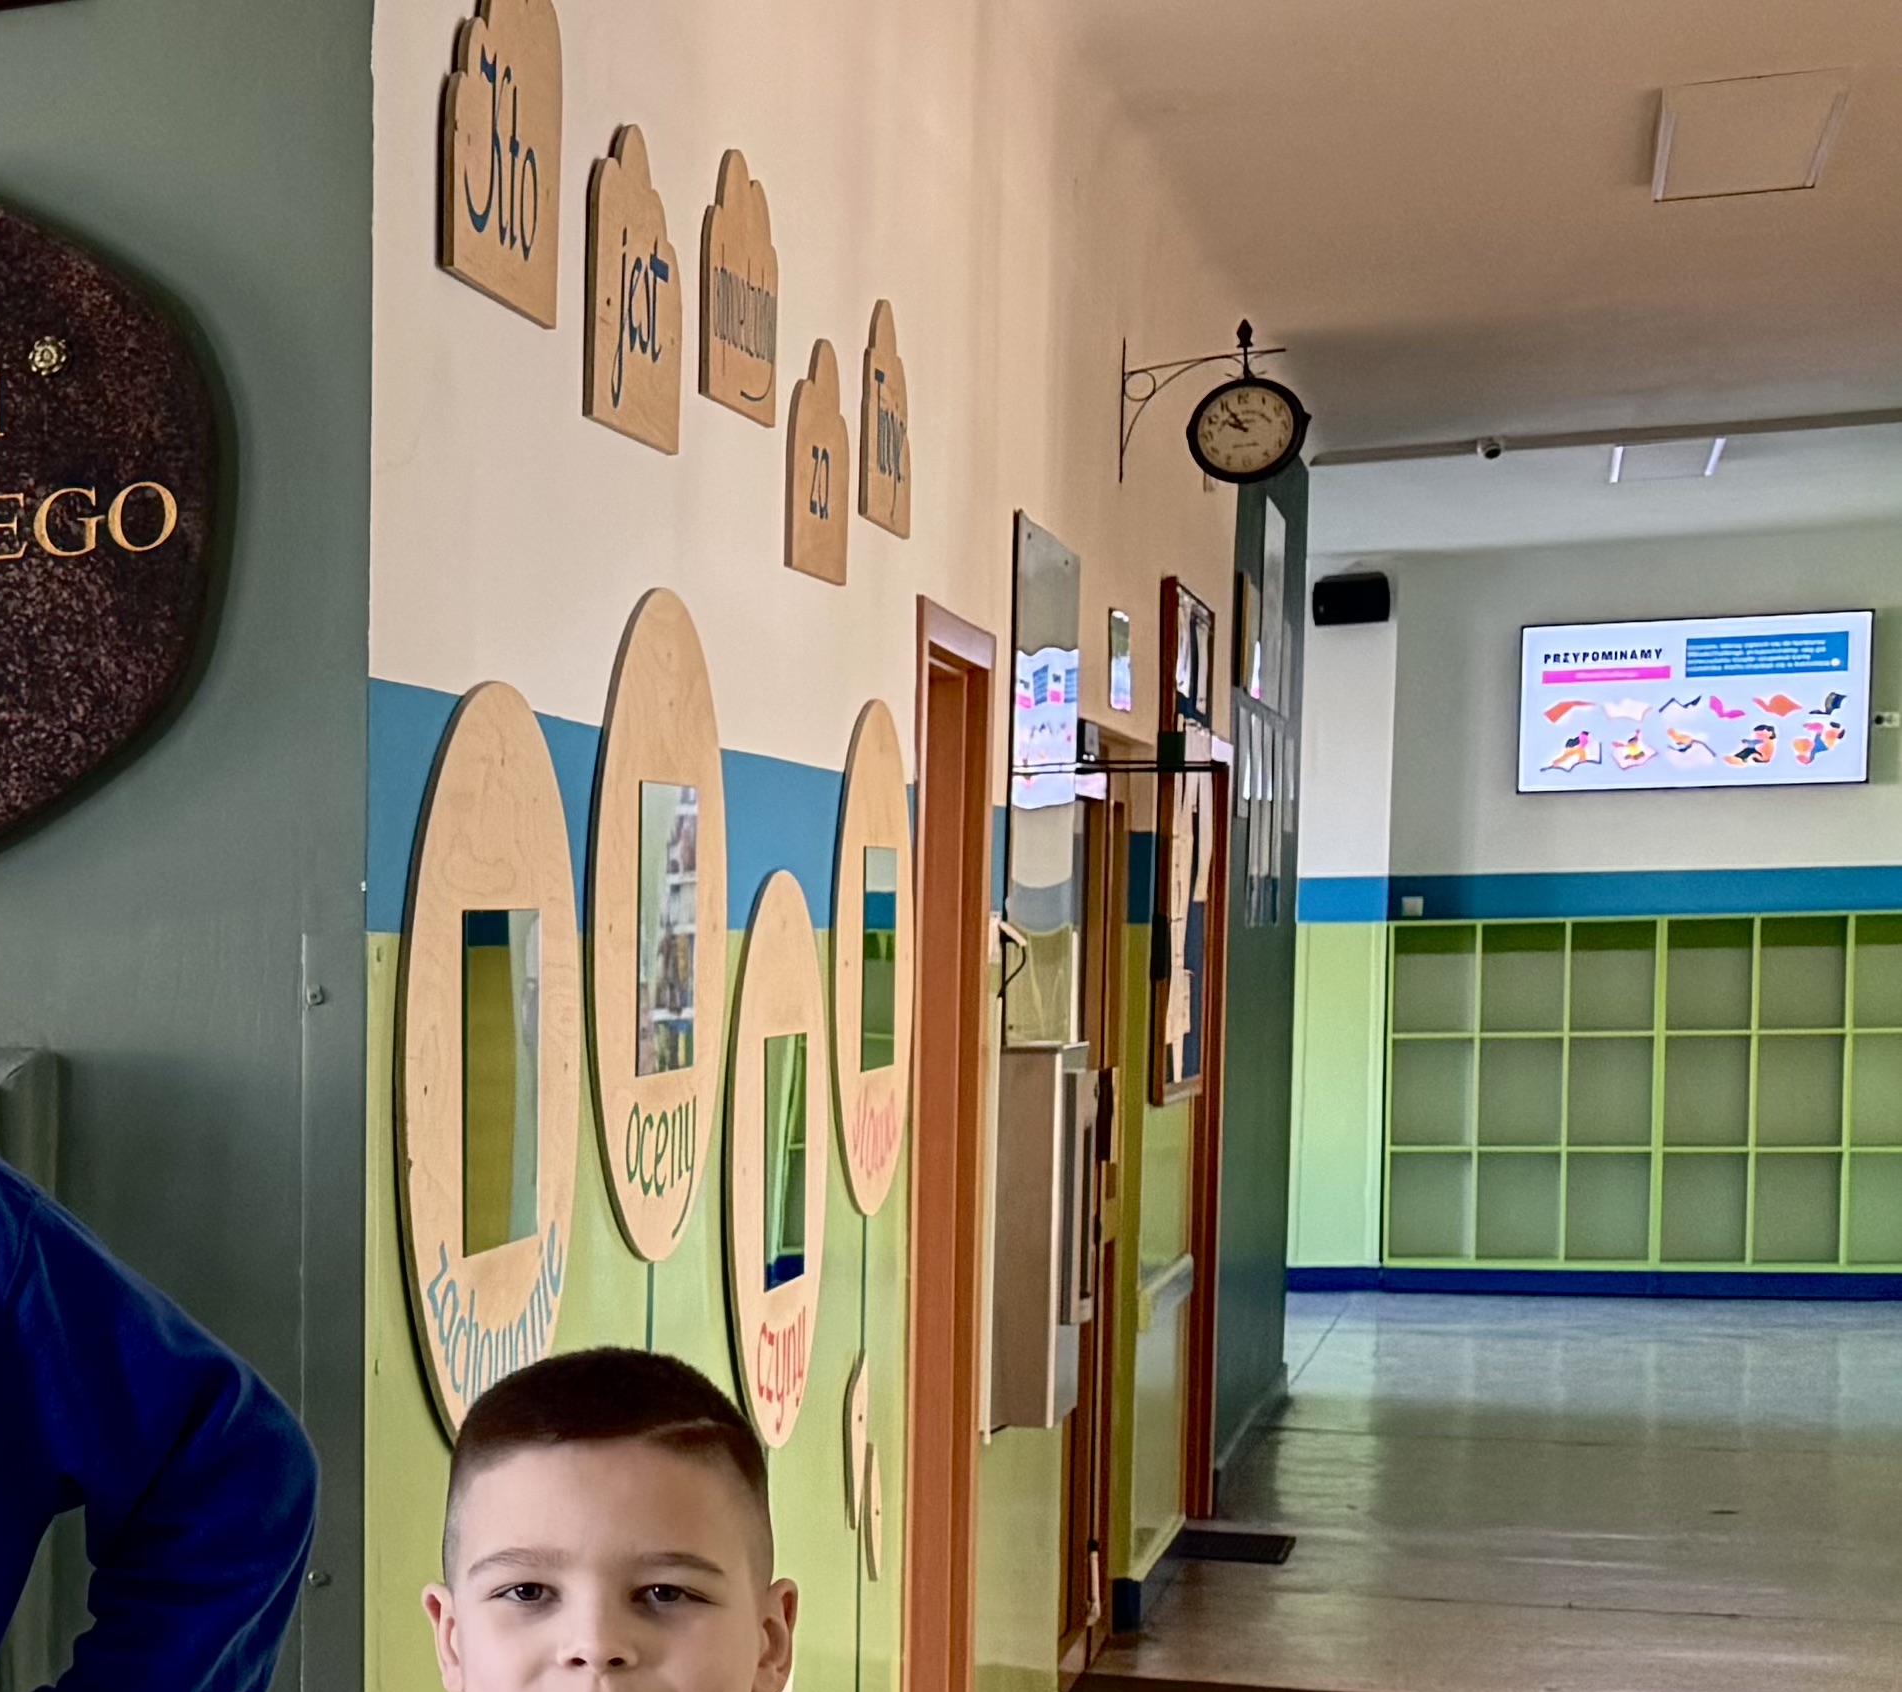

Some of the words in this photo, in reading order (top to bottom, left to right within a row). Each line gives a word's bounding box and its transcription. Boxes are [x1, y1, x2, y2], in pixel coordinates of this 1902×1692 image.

[464, 43, 538, 261] Kto
[611, 227, 669, 408] jest
[809, 445, 829, 520] za
[626, 1095, 696, 1240] oceny
[757, 1305, 806, 1435] czyny
